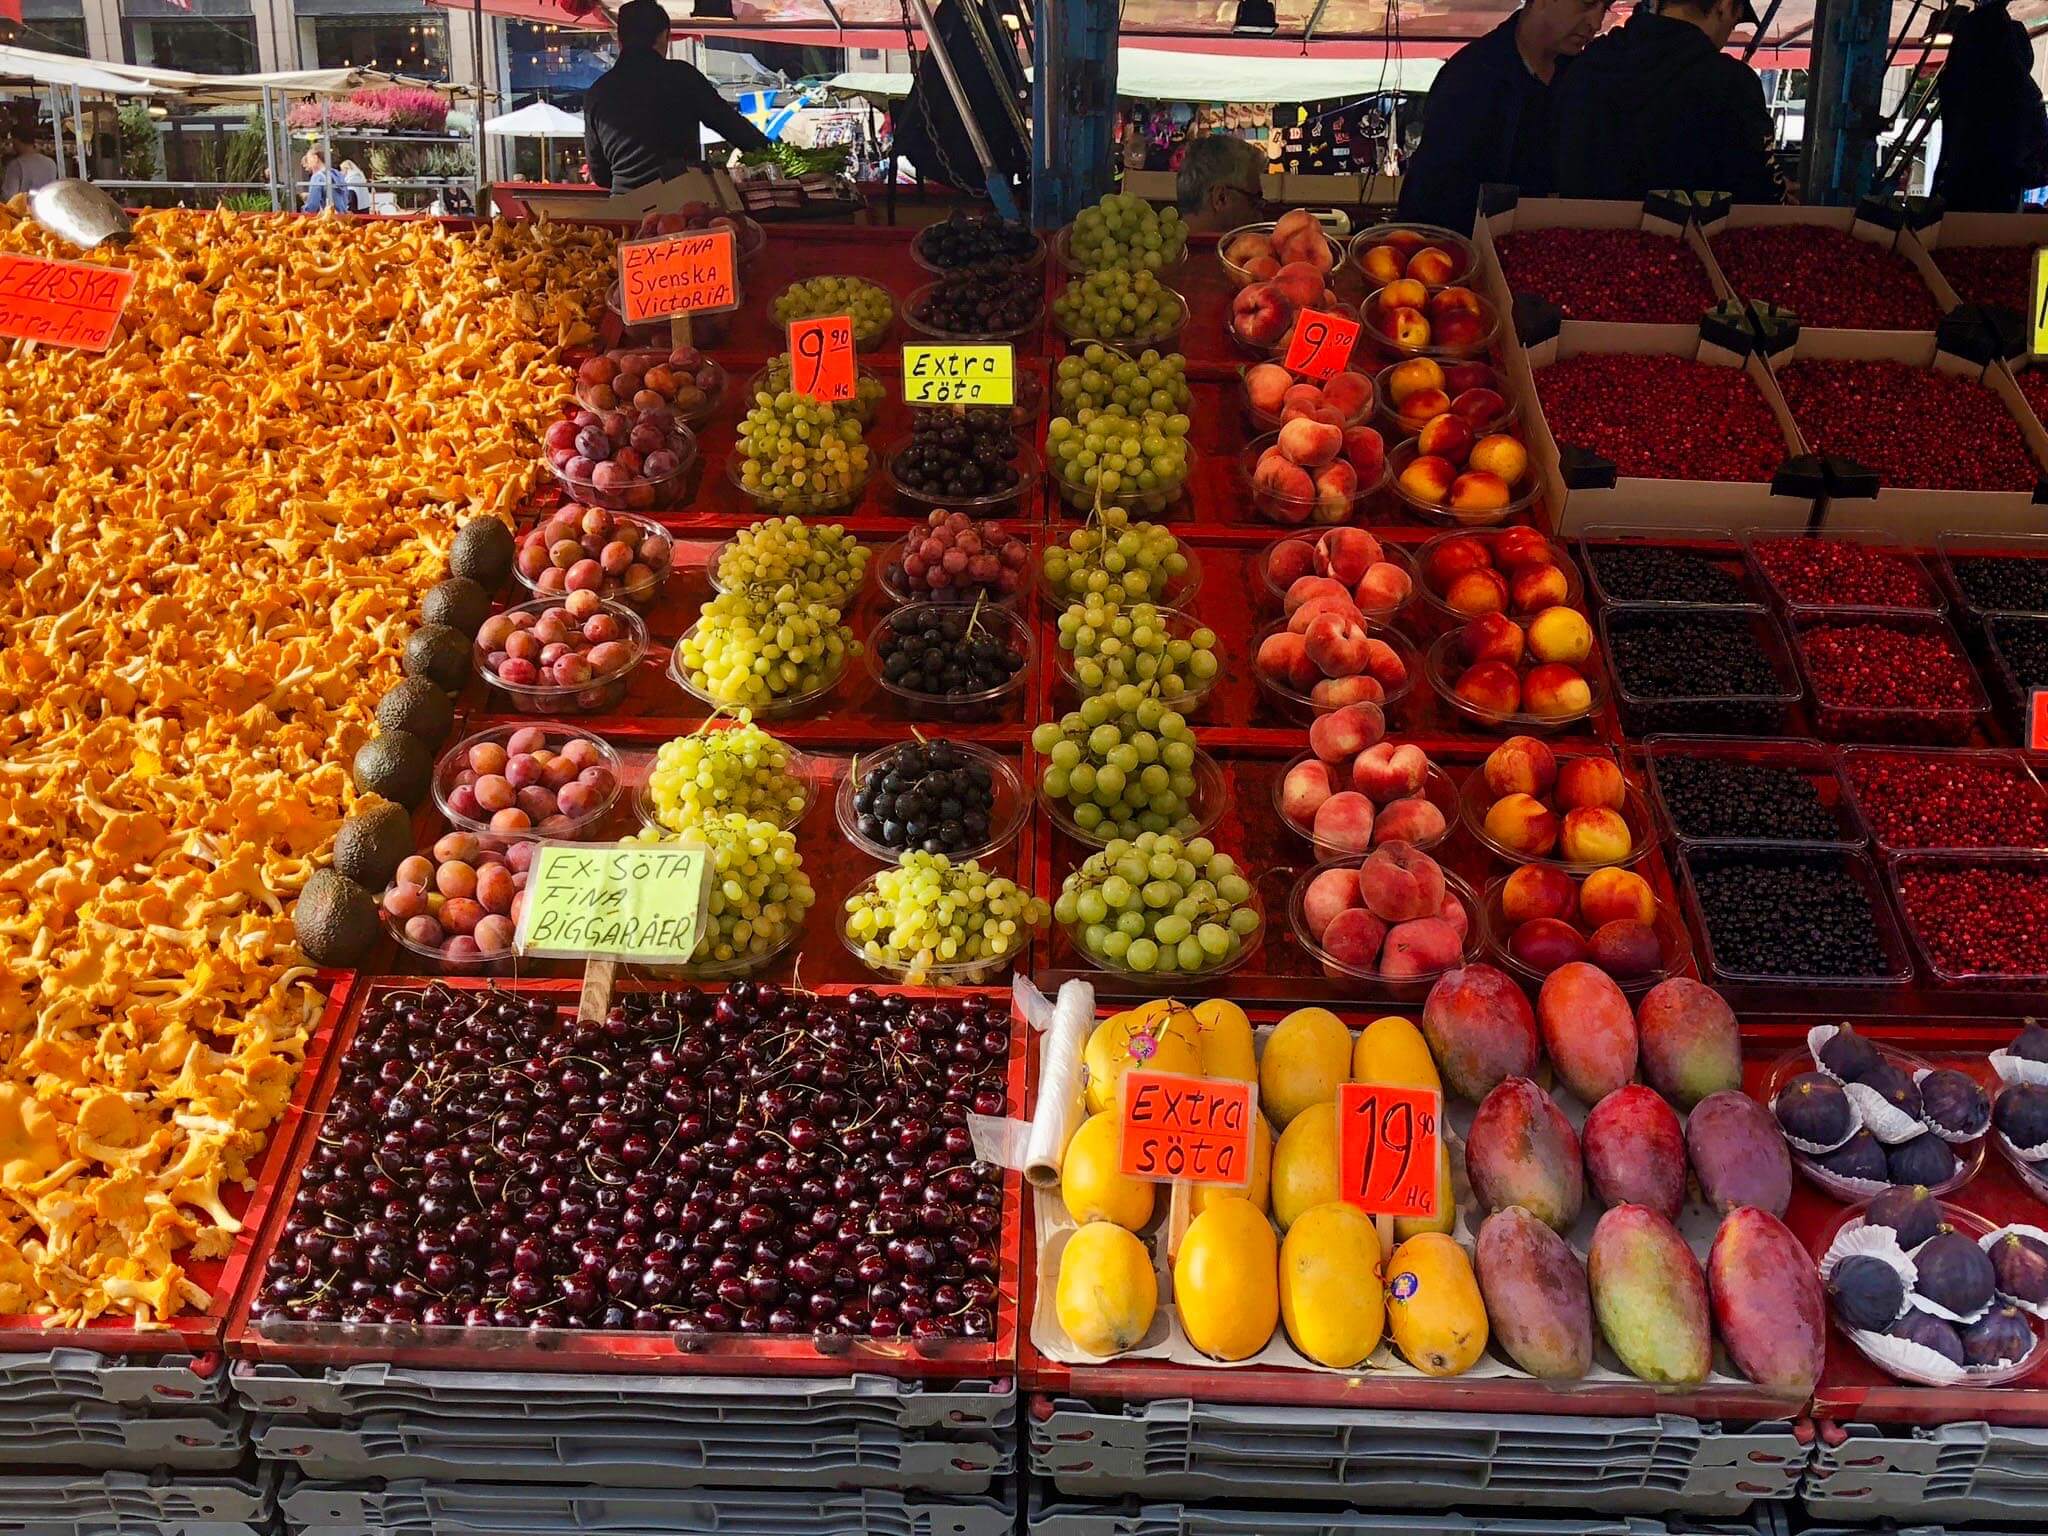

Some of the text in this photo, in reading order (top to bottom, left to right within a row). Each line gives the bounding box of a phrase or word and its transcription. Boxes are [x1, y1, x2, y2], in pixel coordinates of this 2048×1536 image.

[0, 261, 119, 307] FÄRSKA
[0, 302, 106, 342] orra-fina
[1299, 322, 1328, 368] 9
[799, 325, 849, 394] 9 90
[912, 353, 995, 377] Extra
[1131, 1084, 1243, 1132] Extra
[1355, 1095, 1435, 1201] 19 90
[1405, 1185, 1432, 1213] HG
